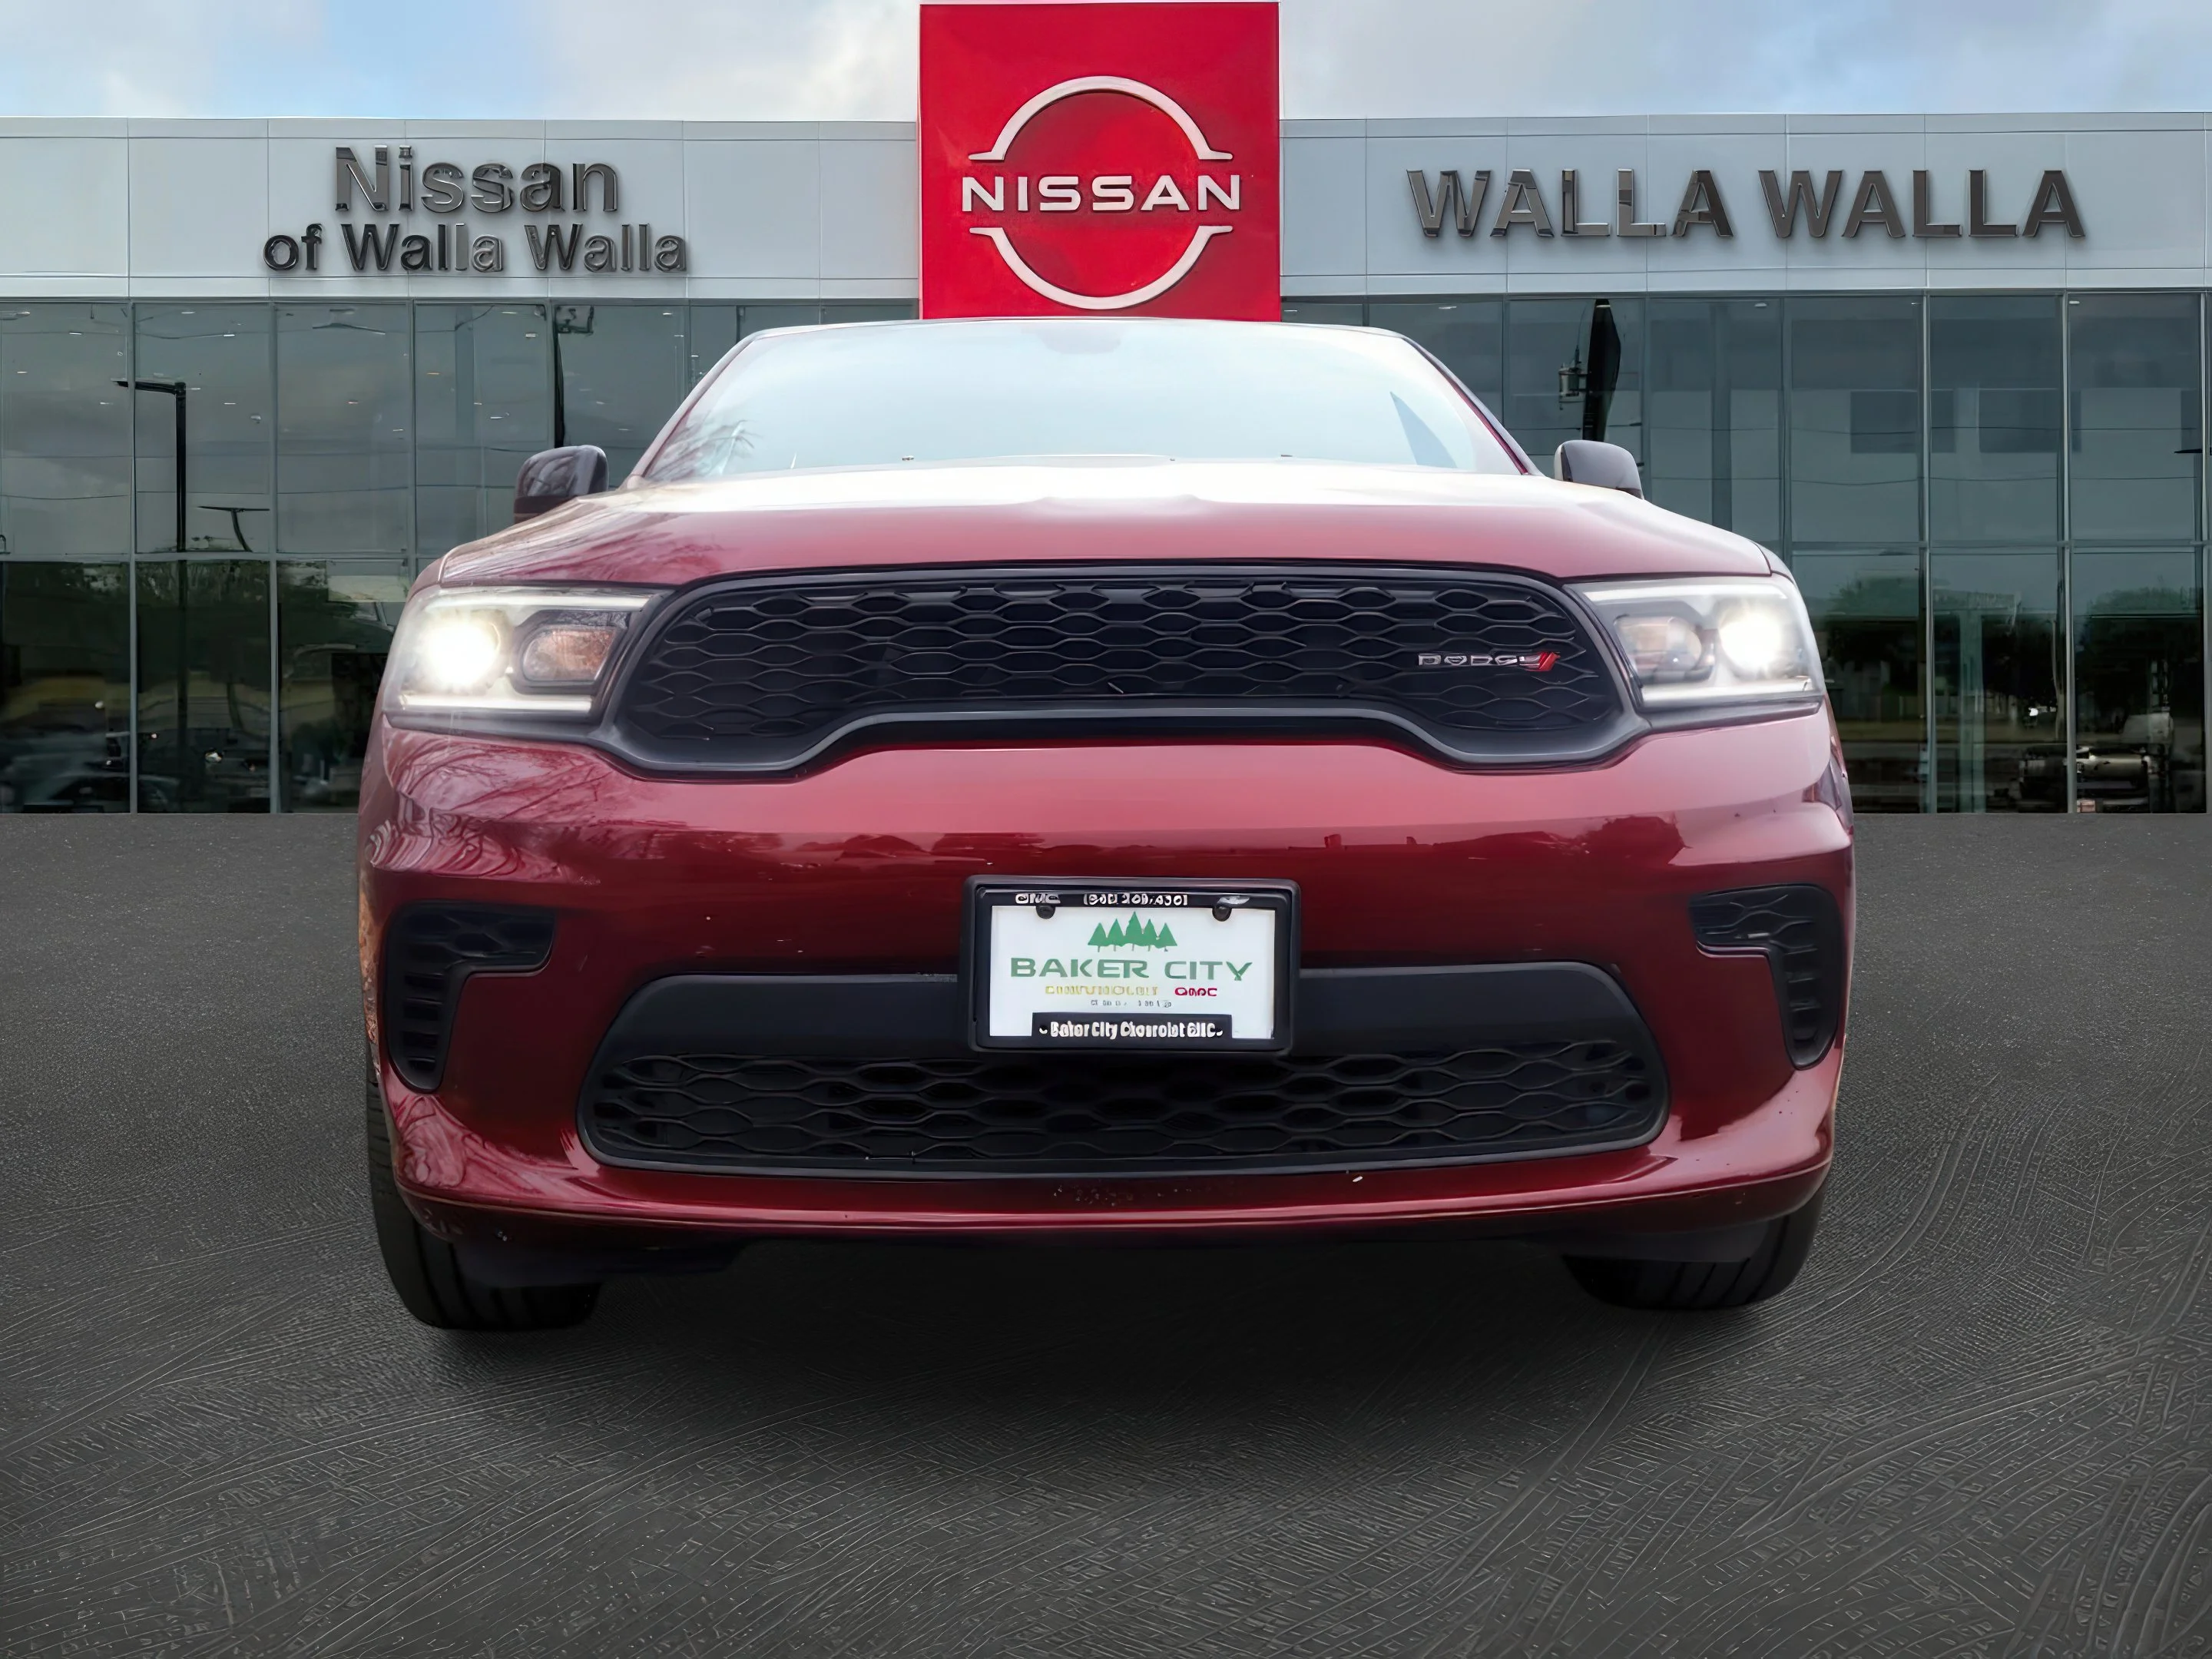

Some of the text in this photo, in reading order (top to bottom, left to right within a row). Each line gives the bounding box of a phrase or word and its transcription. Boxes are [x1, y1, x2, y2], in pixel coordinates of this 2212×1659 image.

[335, 145, 618, 212] Nissan
[962, 174, 1240, 212] NISSAN
[1406, 169, 2085, 238] WALLA WALLA
[263, 223, 687, 272] of Walla Walla
[1010, 958, 1253, 981] BAKER CITY
